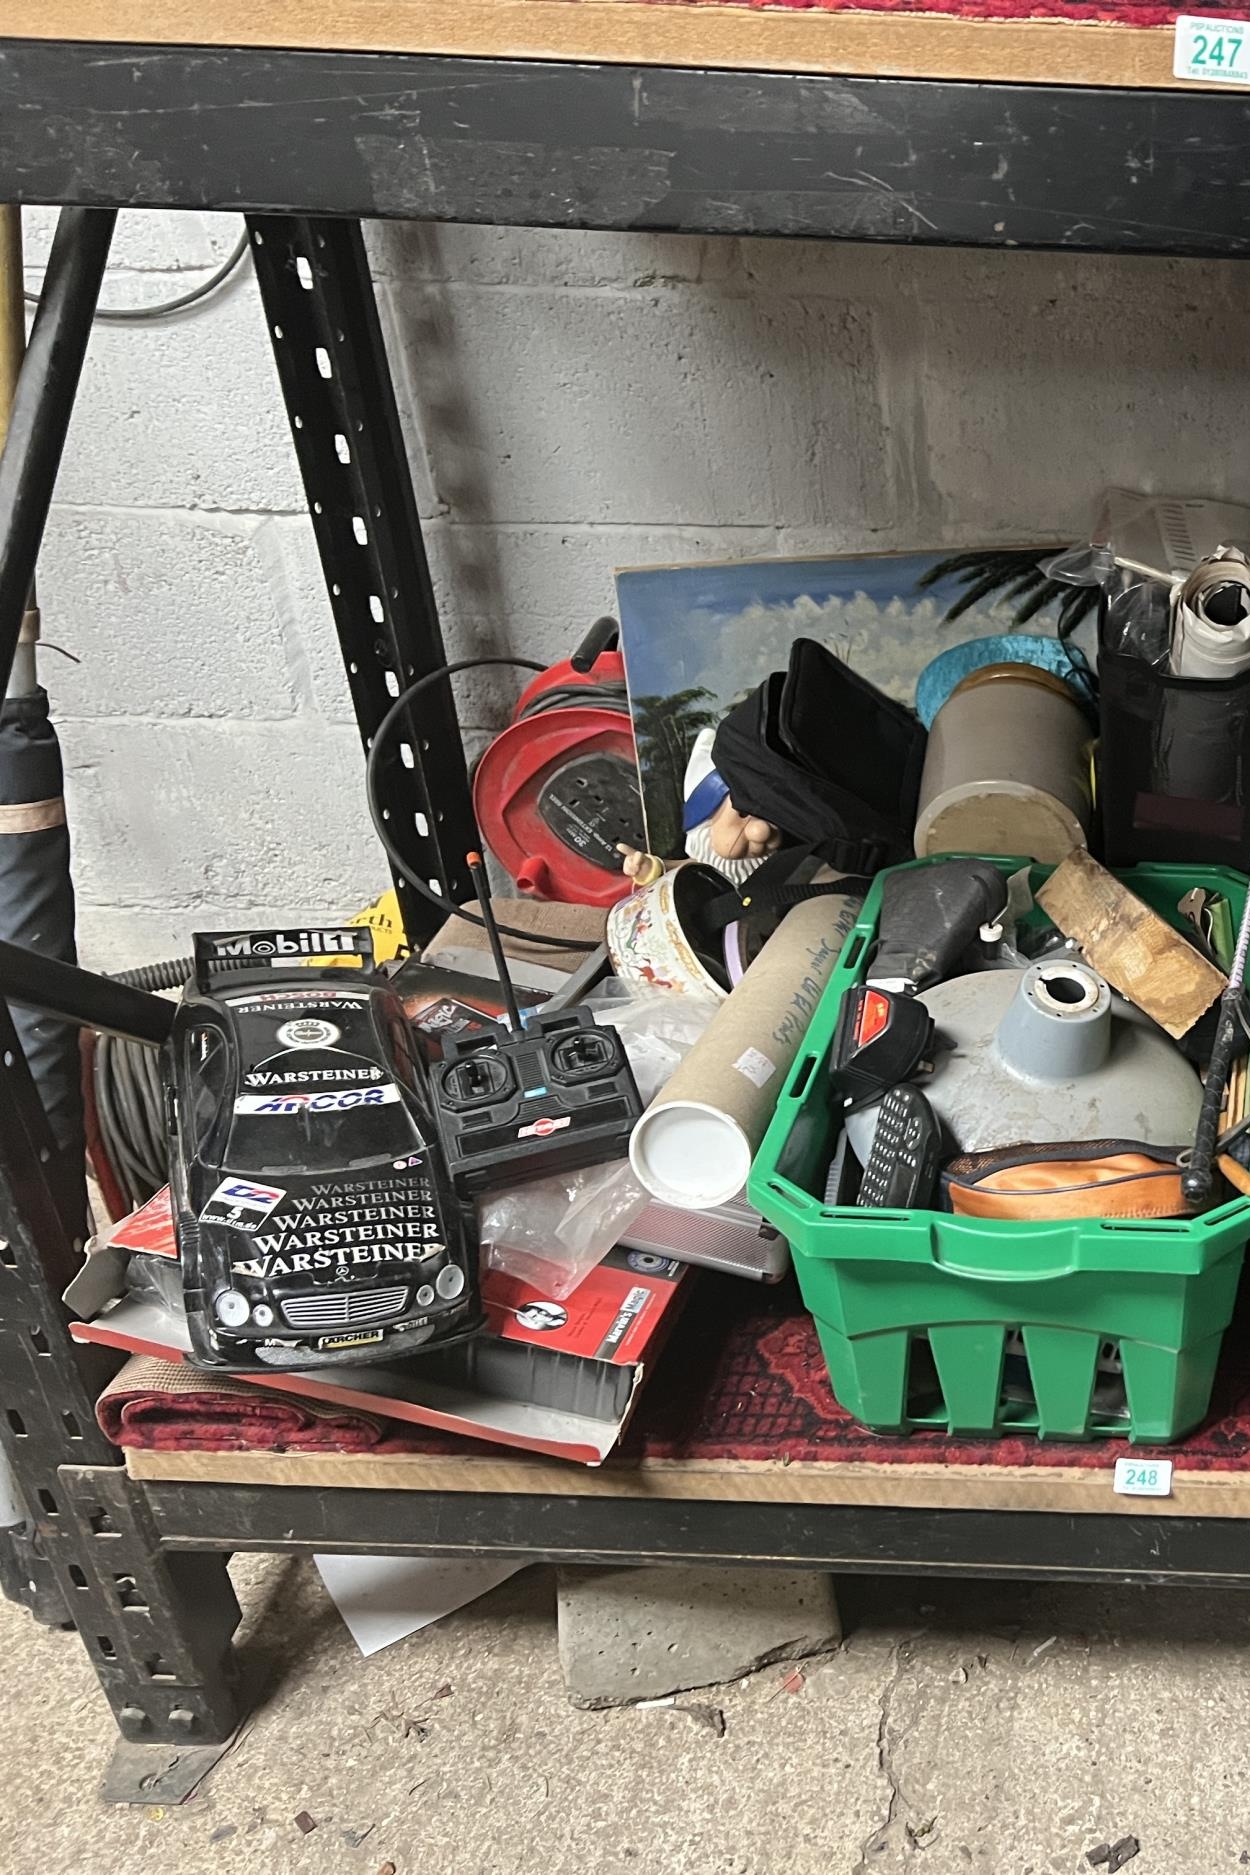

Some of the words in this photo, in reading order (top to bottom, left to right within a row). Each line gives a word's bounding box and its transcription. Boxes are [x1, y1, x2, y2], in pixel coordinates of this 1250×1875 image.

[1191, 34, 1243, 67] 247
[260, 991, 337, 1003] BOSCH
[238, 1001, 363, 1014] WARSTEINER
[245, 1067, 385, 1087] WARSTEINER
[310, 1176, 431, 1195] WARSTEINER
[292, 1189, 432, 1211] WARSTEINER
[272, 1205, 436, 1231] WARSTEINER
[252, 1222, 440, 1254] WARSTEINER
[605, 1311, 633, 1343] Marvin's
[322, 1331, 379, 1346] LARCHER
[1125, 1469, 1158, 1486] 248
